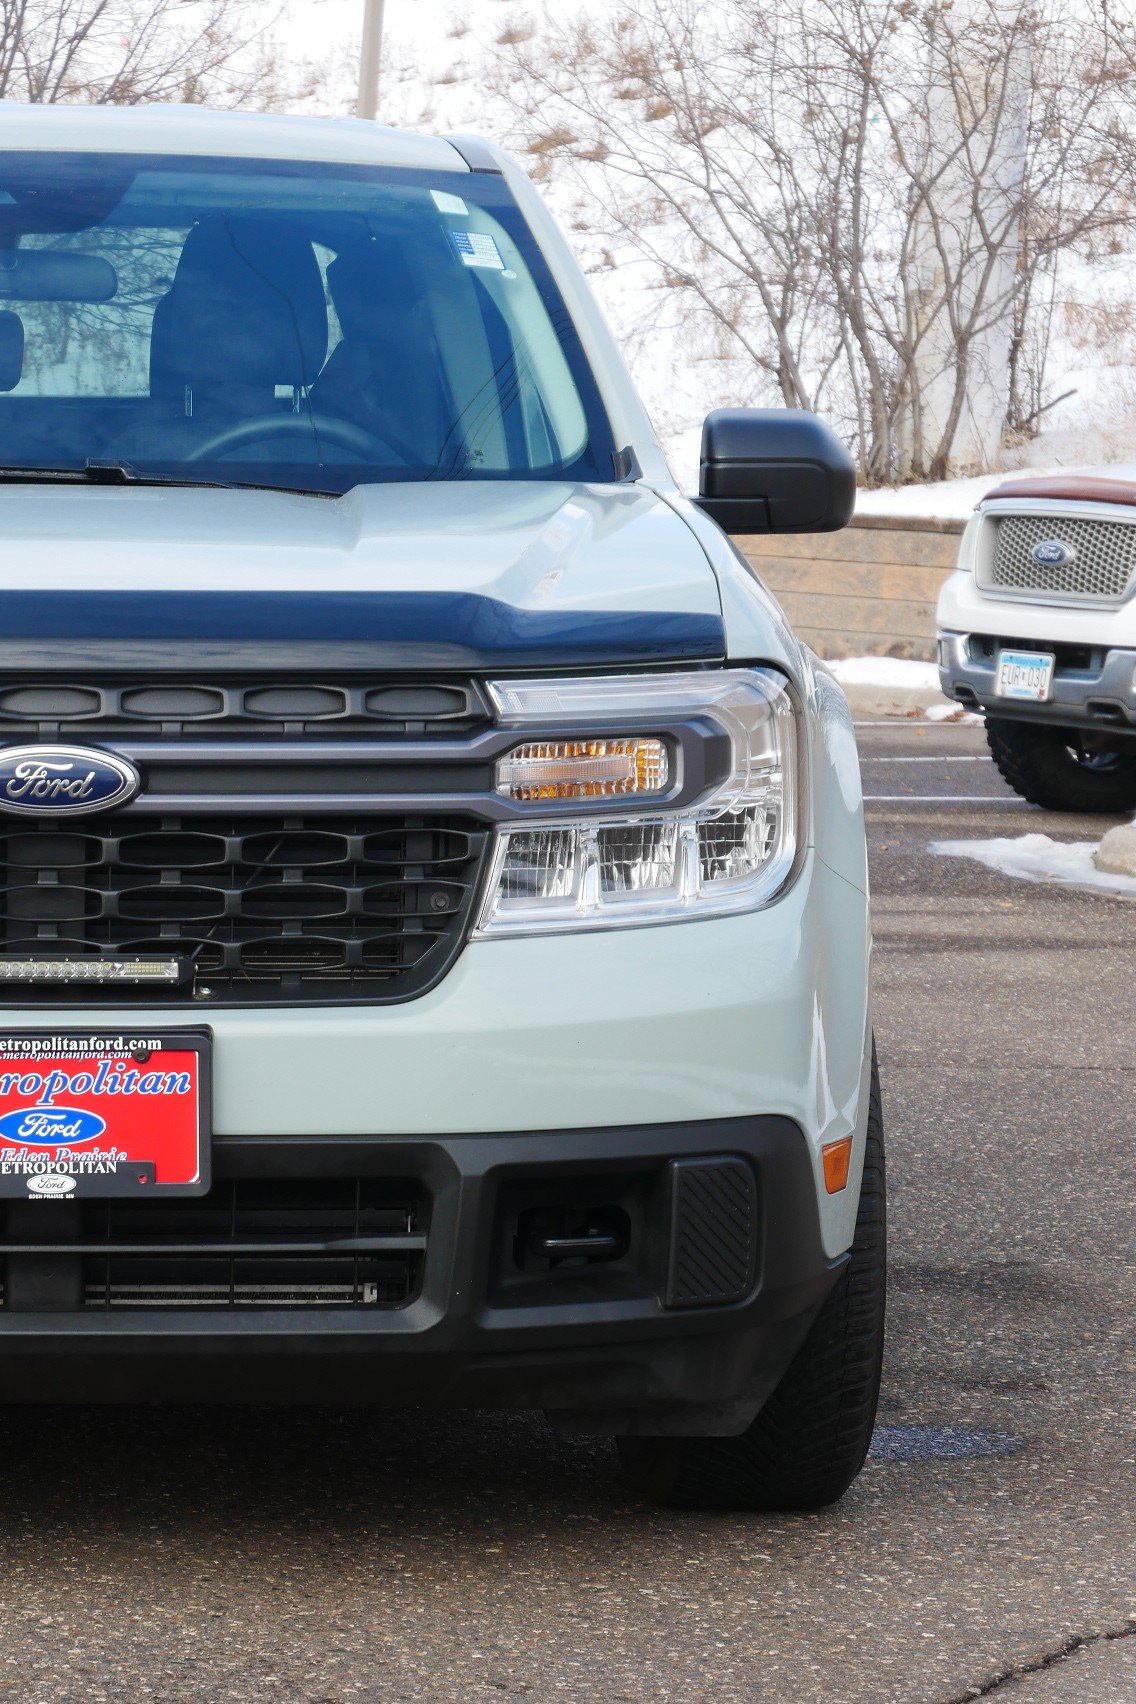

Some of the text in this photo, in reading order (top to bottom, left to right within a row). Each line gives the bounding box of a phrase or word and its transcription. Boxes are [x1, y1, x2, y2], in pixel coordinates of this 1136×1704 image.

[1038, 545, 1061, 560] Ford
[6, 761, 95, 798] Ford
[17, 1112, 83, 1138] Ford
[55, 1146, 128, 1162] Prairie
[37, 1177, 66, 1189] Ford
